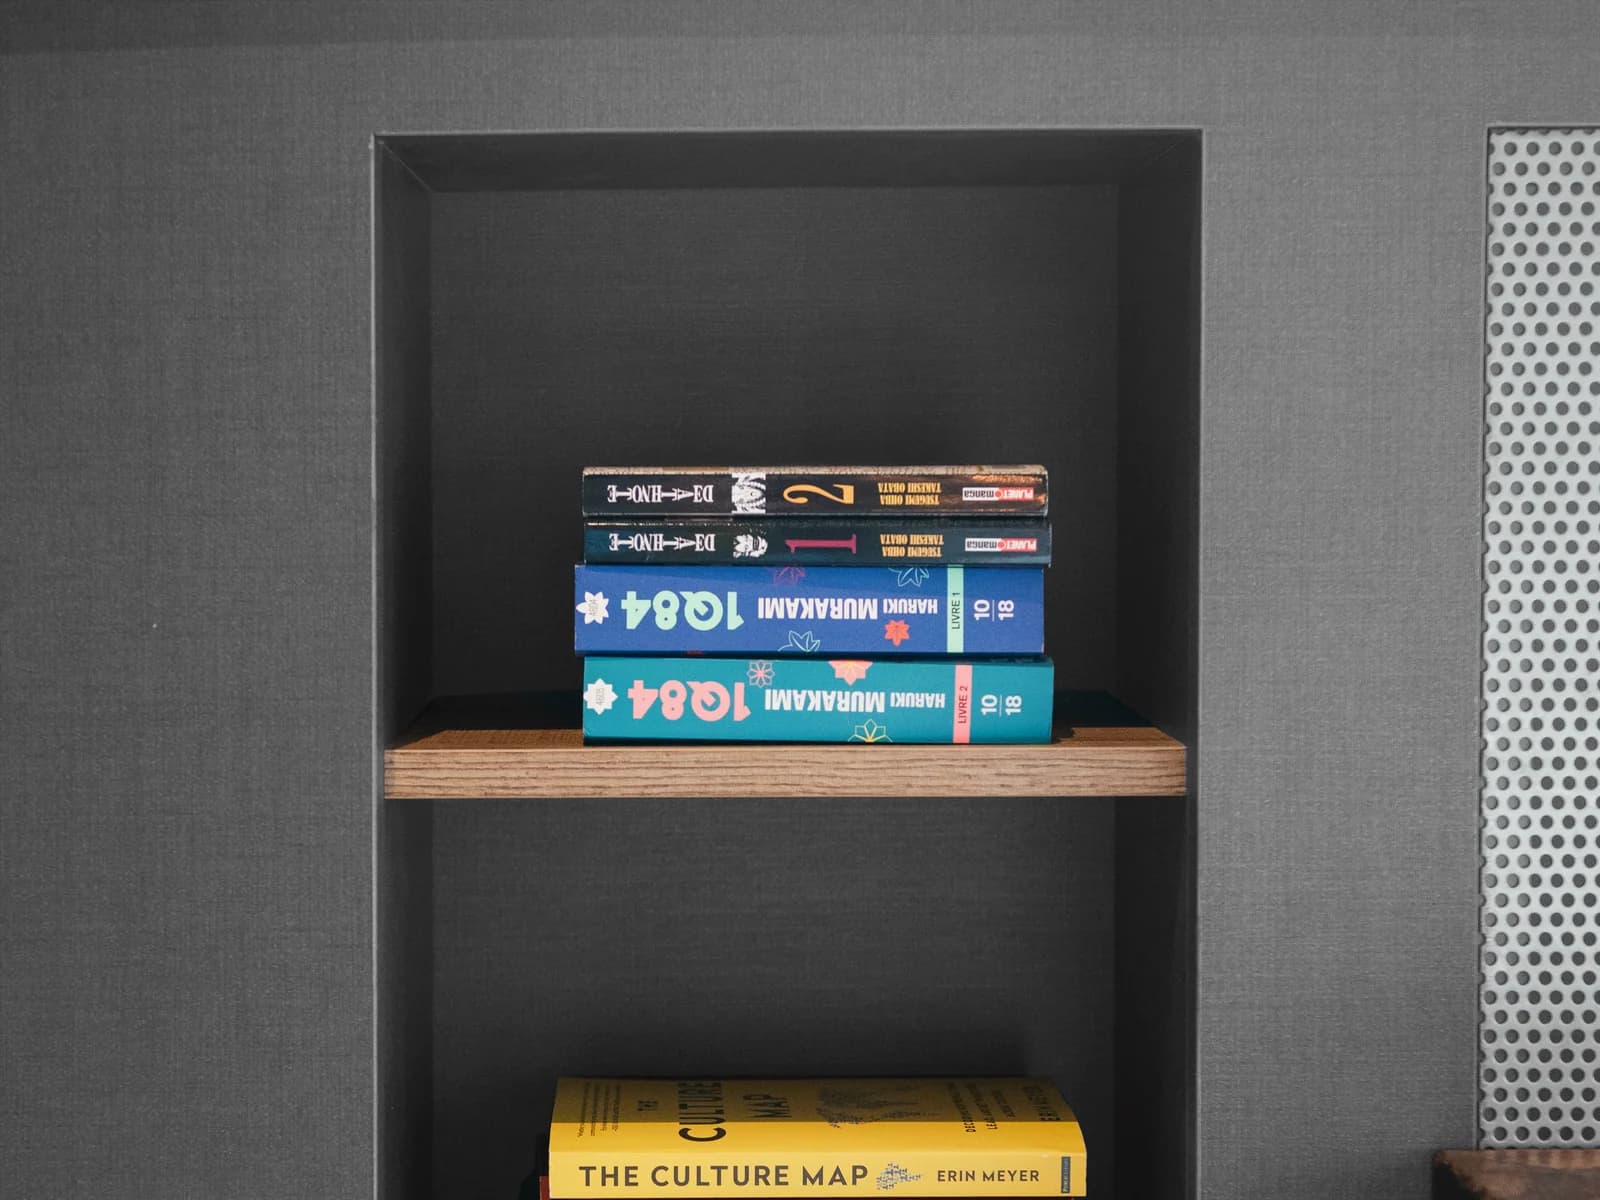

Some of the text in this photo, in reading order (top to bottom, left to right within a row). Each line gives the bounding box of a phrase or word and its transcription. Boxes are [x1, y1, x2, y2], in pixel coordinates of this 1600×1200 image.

[783, 484, 854, 504] 2
[878, 482, 942, 494] TAKESHI OBATA
[907, 495, 940, 505] TSUGUMI
[785, 534, 856, 554] 1
[880, 534, 944, 545] TAKESHI OBATA
[908, 547, 942, 557] TSUGUMI
[621, 590, 745, 631] 1Q84
[758, 597, 938, 619] HARUKI MURAKAMI
[951, 600, 961, 630] LIVRE
[974, 600, 990, 621] 10
[998, 600, 1014, 621] 18
[627, 680, 751, 722] 1Q84
[764, 689, 946, 712] HARUKI MURAKAMI
[958, 695, 968, 724] LIVRE
[981, 694, 998, 716] 10
[1005, 695, 1022, 716] 18
[678, 1082, 727, 1142] CULTURE
[579, 1165, 868, 1187] THE CULTURE MAP
[937, 1170, 1040, 1182] ERIN MEYER
